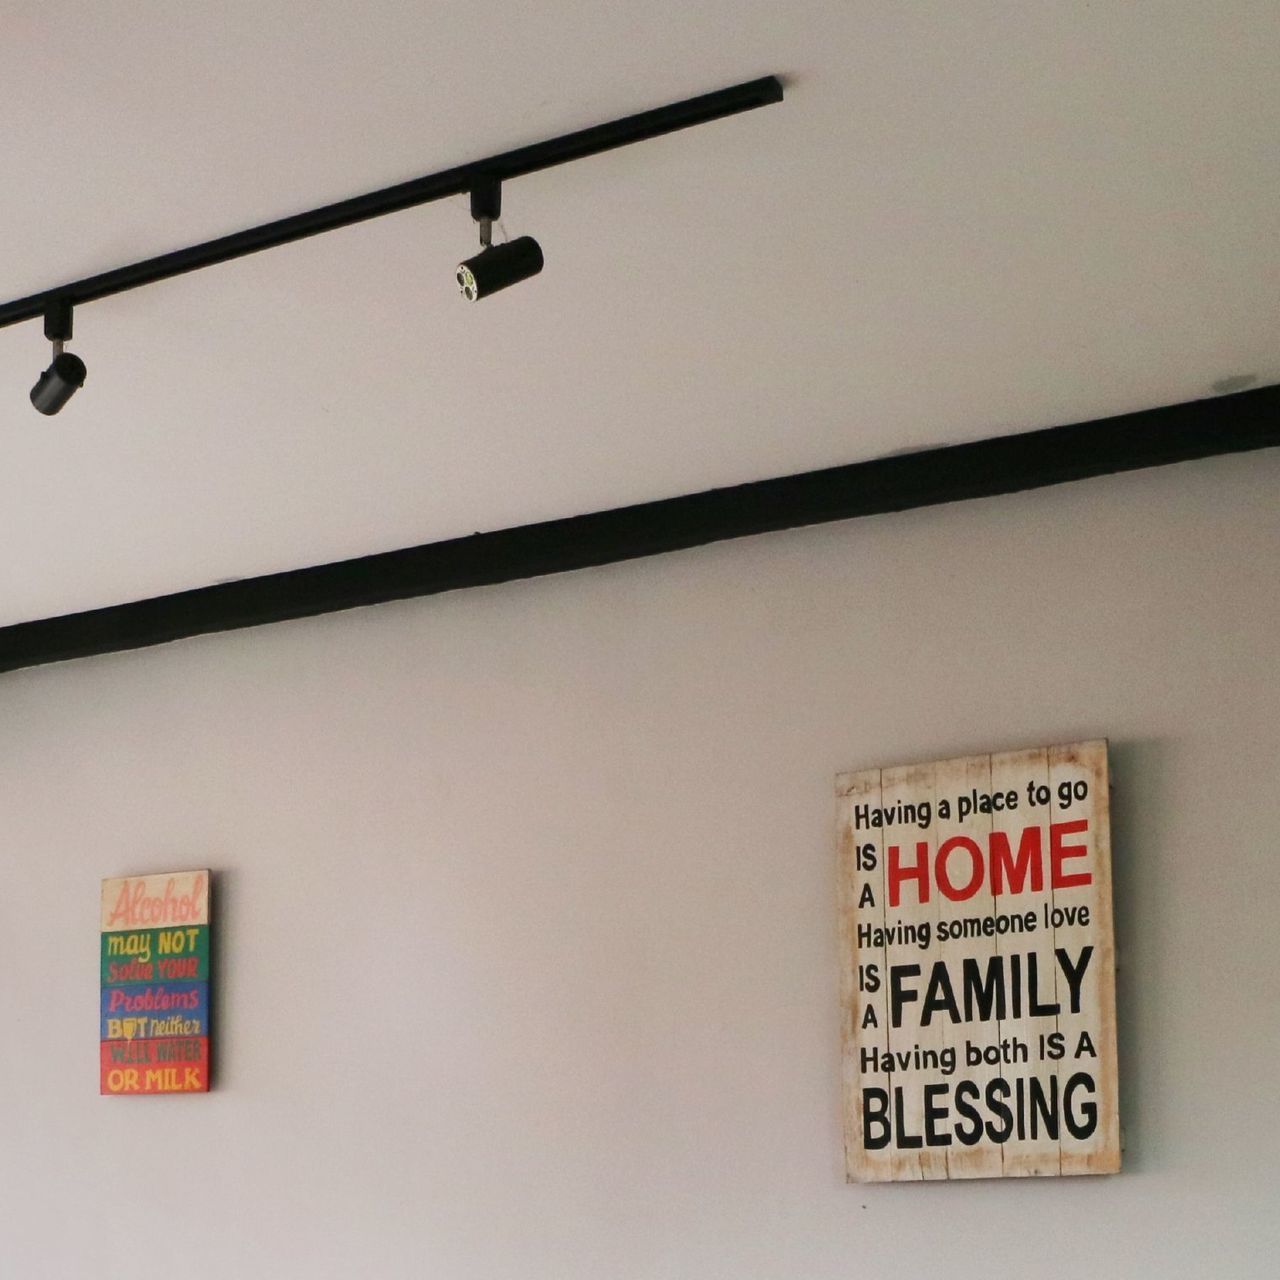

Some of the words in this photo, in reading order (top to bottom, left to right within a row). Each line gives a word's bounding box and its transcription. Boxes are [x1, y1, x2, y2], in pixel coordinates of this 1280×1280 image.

[854, 799, 931, 831] Having
[937, 798, 951, 820] a
[957, 788, 1019, 825] place
[1027, 780, 1051, 807] to
[1058, 779, 1089, 810] go
[856, 844, 878, 872] IS
[887, 819, 1092, 907] HOME
[107, 874, 204, 927] Alcohol
[858, 883, 876, 909] A
[857, 921, 932, 949] Having
[936, 912, 1038, 941] someone
[1044, 903, 1091, 929] love
[107, 934, 151, 963] may
[158, 928, 200, 955] NOT
[158, 956, 199, 980] YOUR
[859, 964, 881, 993] IS
[108, 985, 199, 1013] Problems
[889, 945, 1094, 1029] FAMILY
[107, 1016, 147, 1041] BUT
[150, 1015, 200, 1037] neither
[862, 1003, 879, 1030] A
[110, 1039, 150, 1064] WILL
[157, 1039, 201, 1062] WATER
[860, 1046, 956, 1076] Having
[965, 1038, 1028, 1068] both
[1039, 1033, 1066, 1060] IS
[1073, 1031, 1097, 1058] A
[108, 1069, 139, 1091] OR
[146, 1066, 201, 1090] MILK
[862, 1071, 1098, 1150] BLESSING
